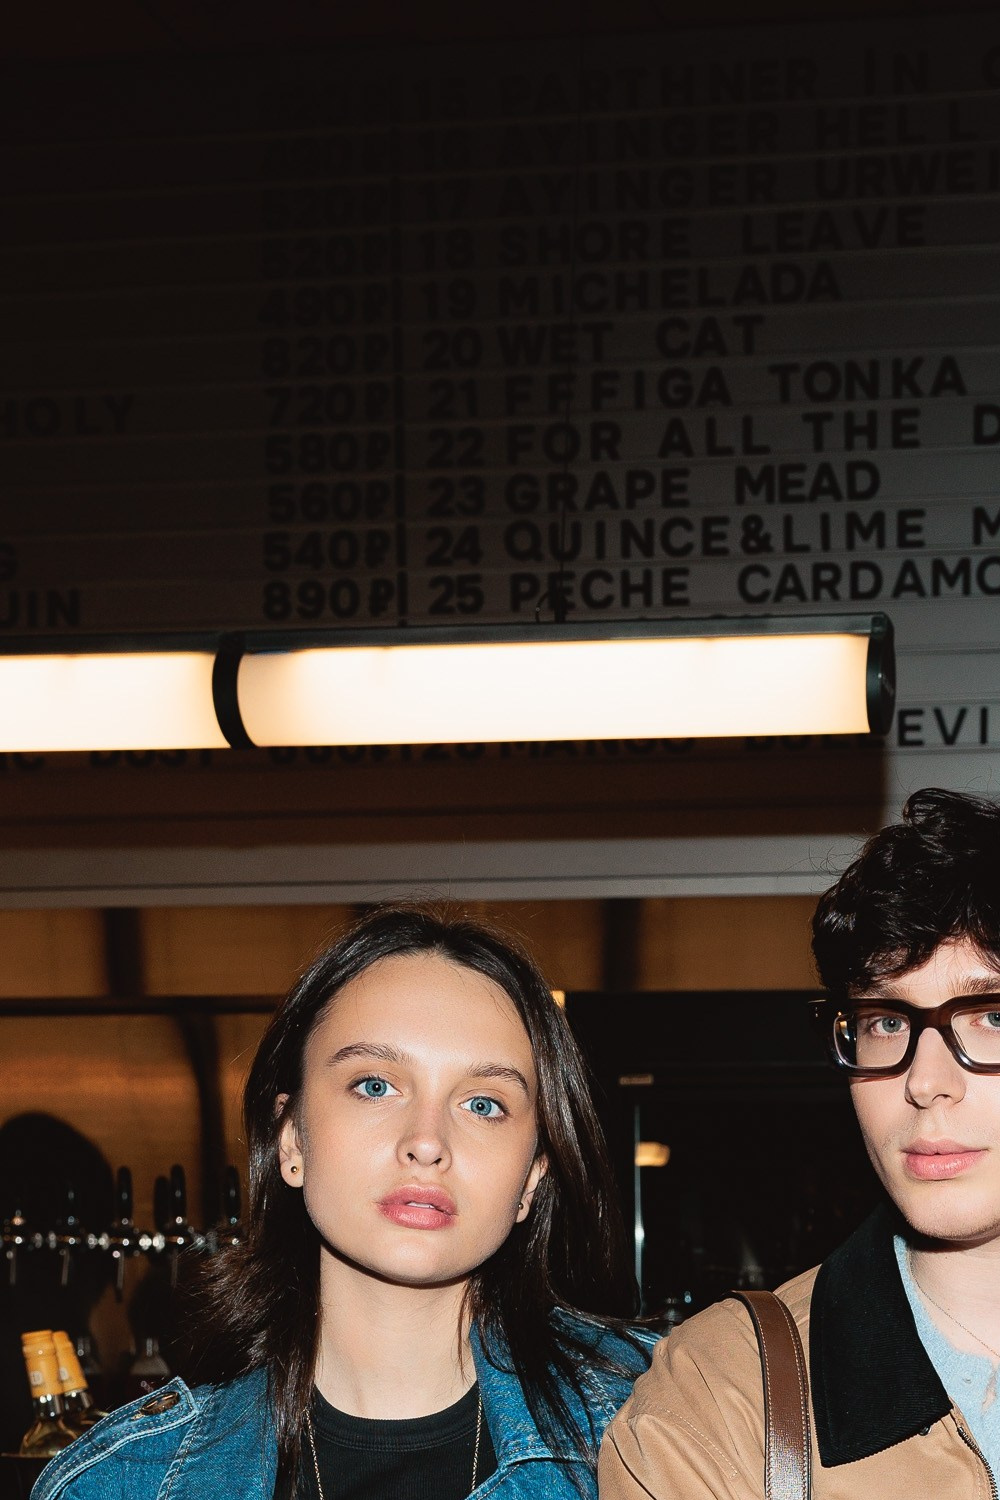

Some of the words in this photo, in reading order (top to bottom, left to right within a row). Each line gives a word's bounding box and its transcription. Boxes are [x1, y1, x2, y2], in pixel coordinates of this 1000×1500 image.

[865, 48, 929, 95] IN
[498, 111, 779, 166] AYINGER
[816, 103, 977, 148] HELL
[418, 180, 472, 220] 17
[498, 164, 777, 216] AYINGER
[419, 228, 474, 270] 18
[498, 219, 691, 266] SHORE
[743, 206, 925, 254] LEAVE
[420, 279, 476, 319] 19
[499, 261, 841, 316] MICHELADA
[261, 333, 390, 377] 820₽
[423, 329, 482, 370] 20
[498, 322, 613, 366] WET
[656, 314, 764, 357] CAT
[264, 382, 390, 426] 720₽
[428, 380, 478, 419] 21
[769, 356, 967, 402] TONKA
[265, 431, 391, 474] 580₽
[427, 427, 484, 468] 22
[506, 421, 621, 463] FOR
[659, 415, 769, 458] ALL
[803, 409, 920, 451] THE
[267, 480, 391, 523] 560₽
[427, 476, 484, 517] 23
[505, 469, 690, 512] GRAPE
[736, 460, 880, 505] MEAD
[262, 529, 391, 571] 540₽
[425, 526, 482, 567] 24
[505, 508, 926, 564] QUINCE&LIME
[262, 577, 394, 620] 890₽
[429, 575, 484, 615] 25
[510, 567, 690, 613] PECHE
